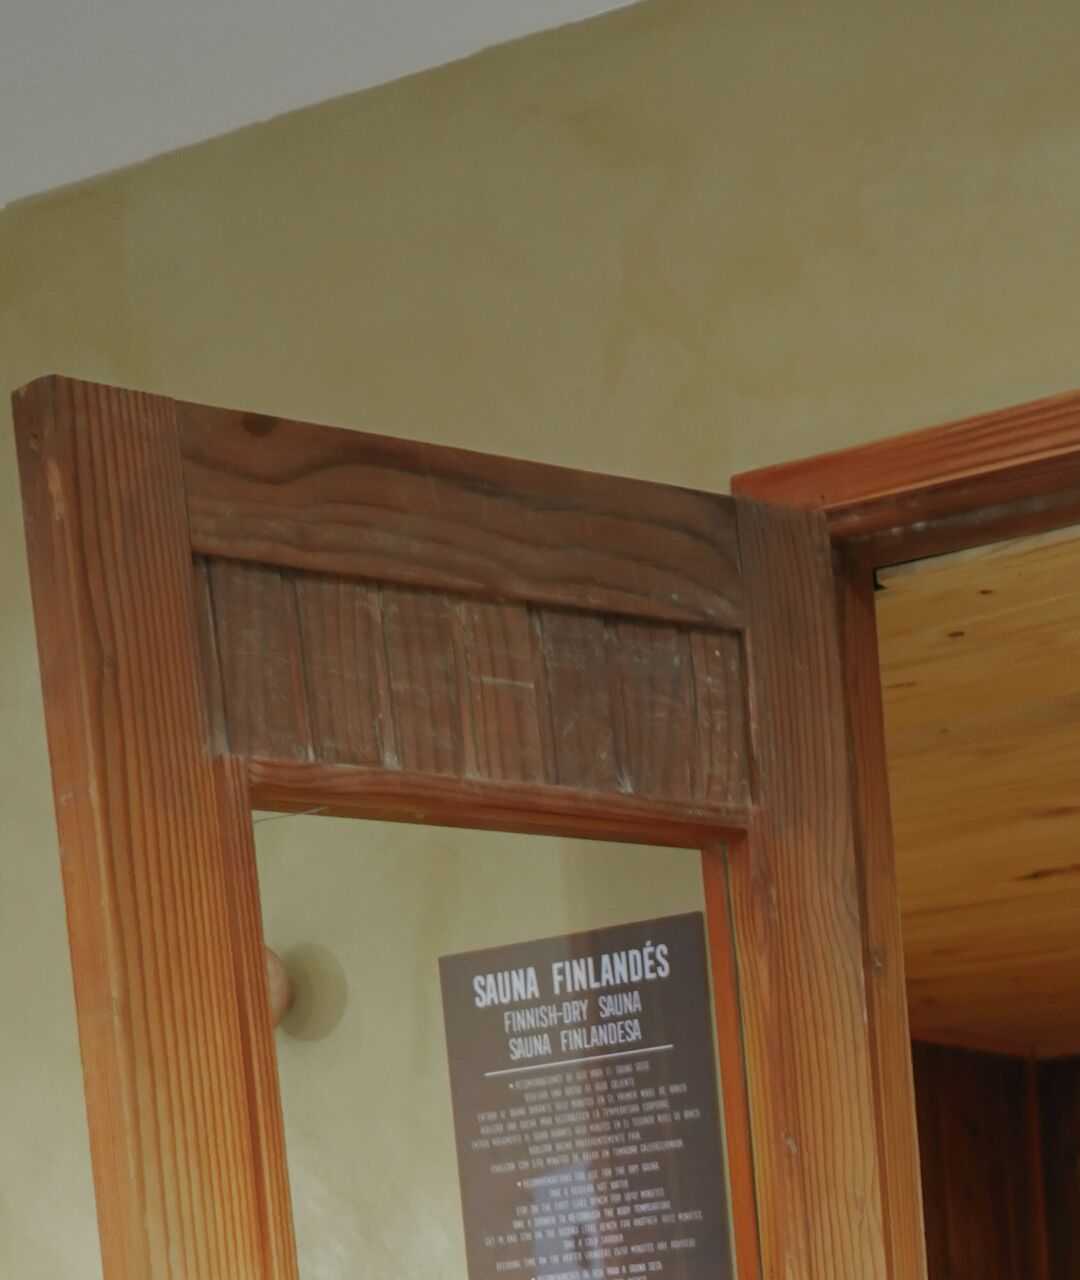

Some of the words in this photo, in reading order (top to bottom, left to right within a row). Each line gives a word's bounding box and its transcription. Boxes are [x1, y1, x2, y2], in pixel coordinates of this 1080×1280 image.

[472, 965, 540, 1009] SAUNA
[550, 940, 671, 996] FINLANDÉS
[503, 998, 589, 1033] FINNISH-DRY
[597, 990, 642, 1018] SAUNA
[508, 1032, 551, 1060] SAUNA
[559, 1018, 642, 1052] FINLANDESA
